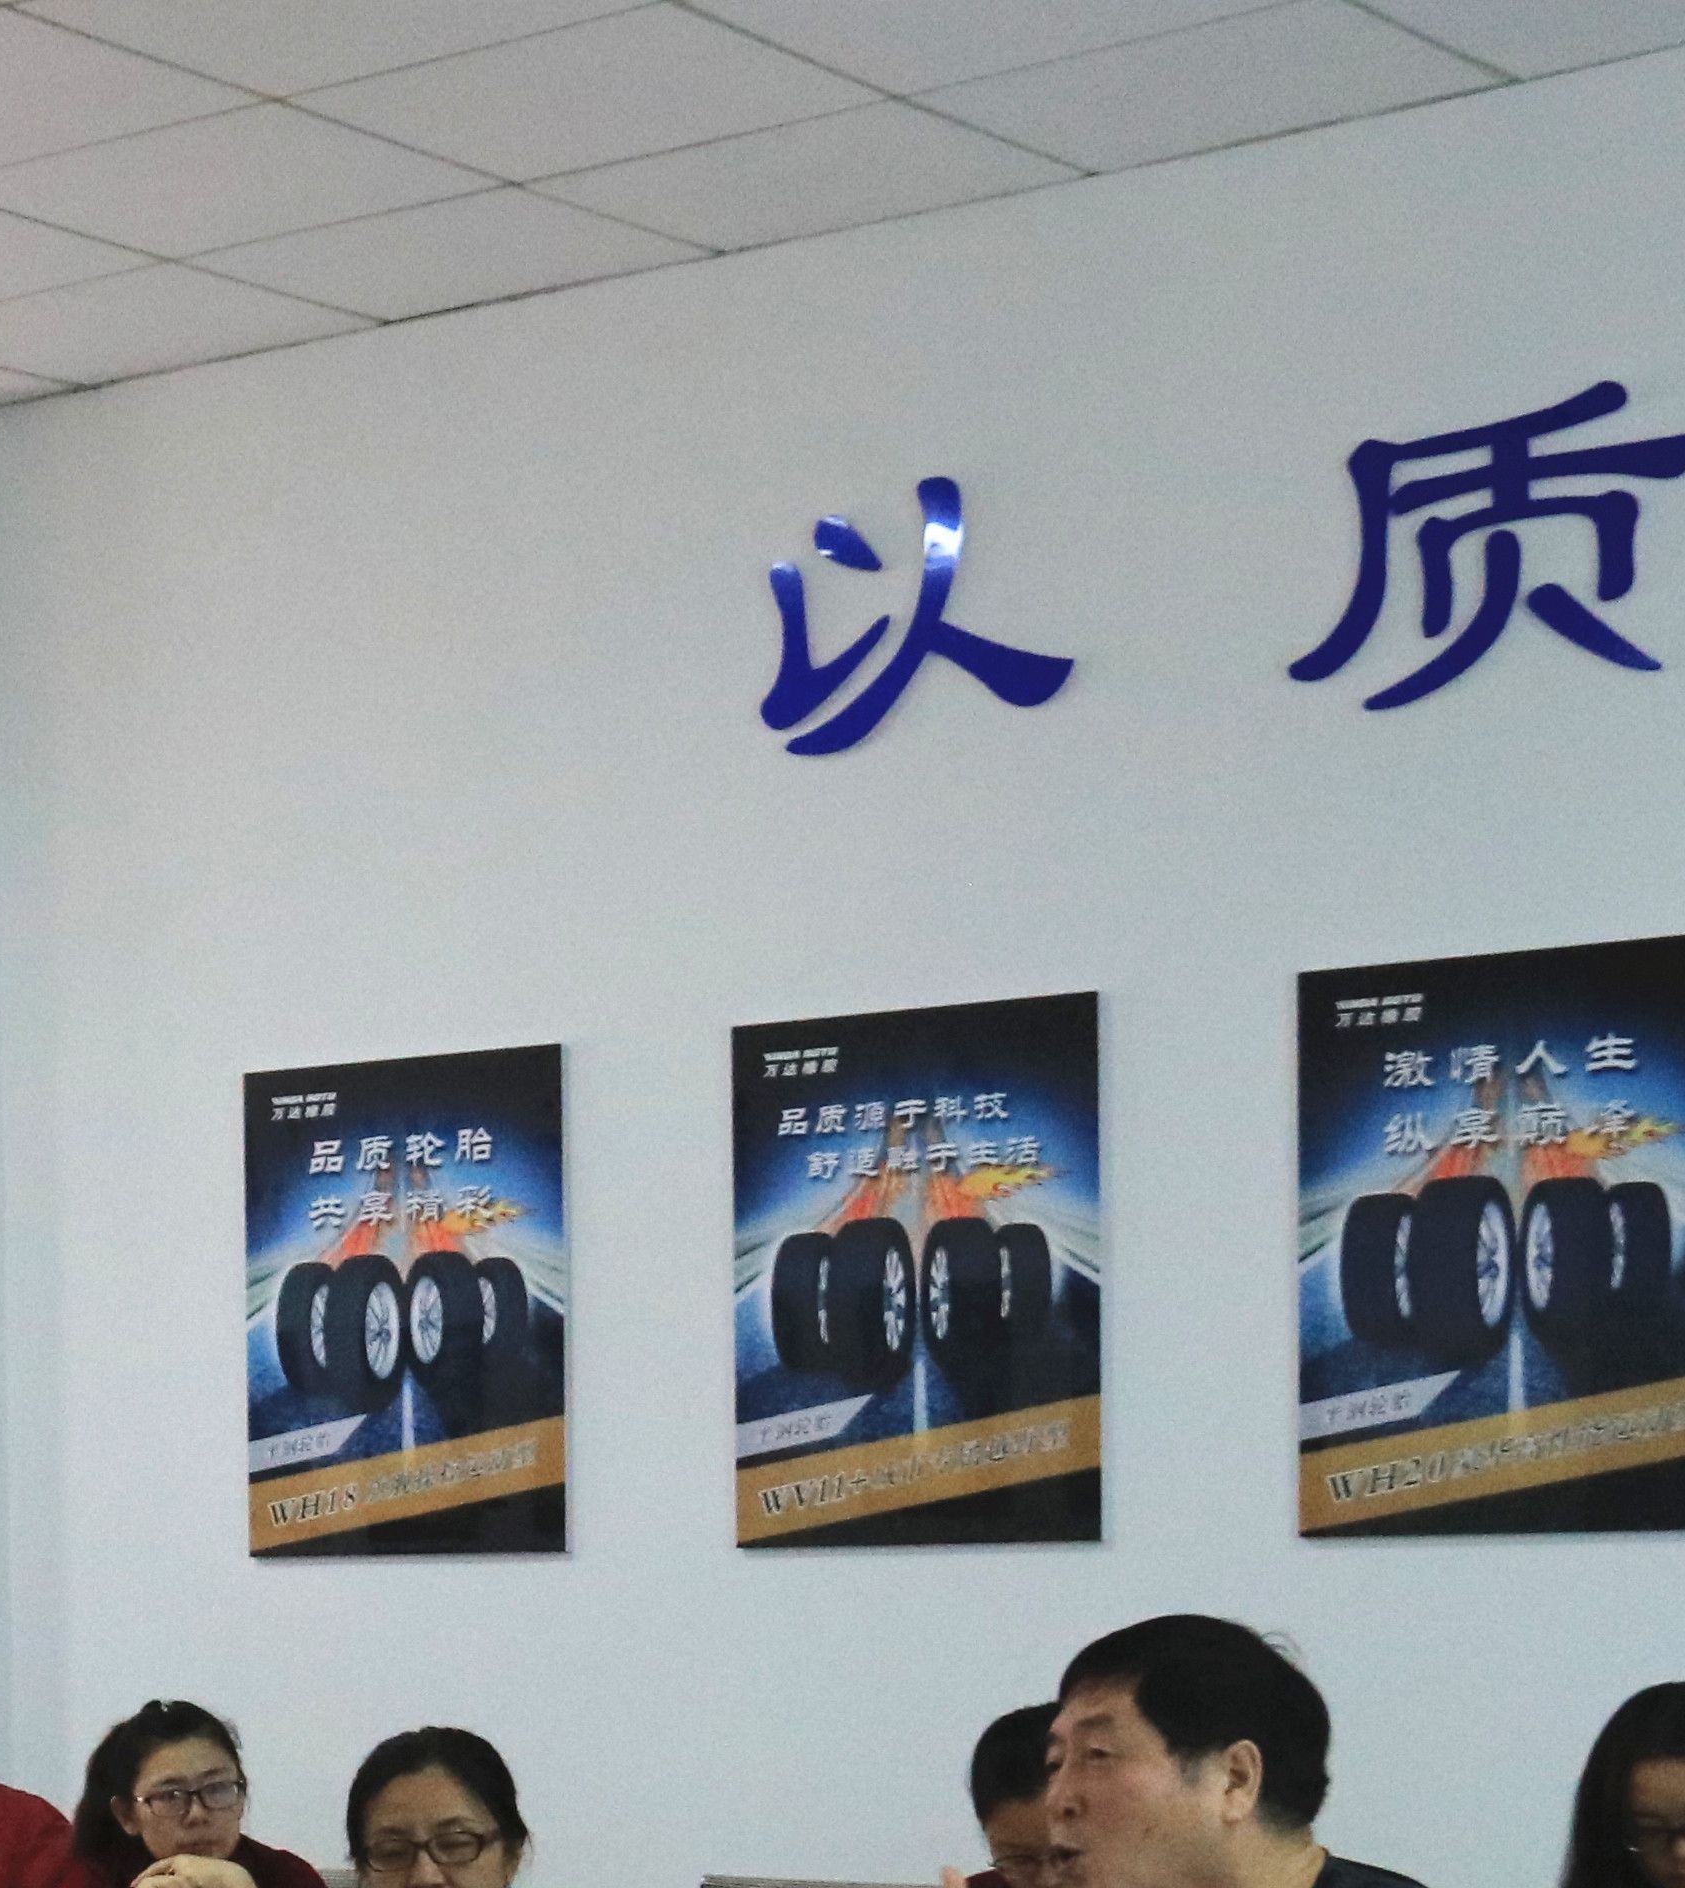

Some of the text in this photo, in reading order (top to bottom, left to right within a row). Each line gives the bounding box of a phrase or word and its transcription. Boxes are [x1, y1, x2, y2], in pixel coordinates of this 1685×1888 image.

[1383, 1033, 1638, 1087] 激情人生
[778, 1092, 1009, 1136] 品质源于科技
[308, 1126, 493, 1175] 品质轮胎
[308, 1185, 494, 1231] 共享精彩
